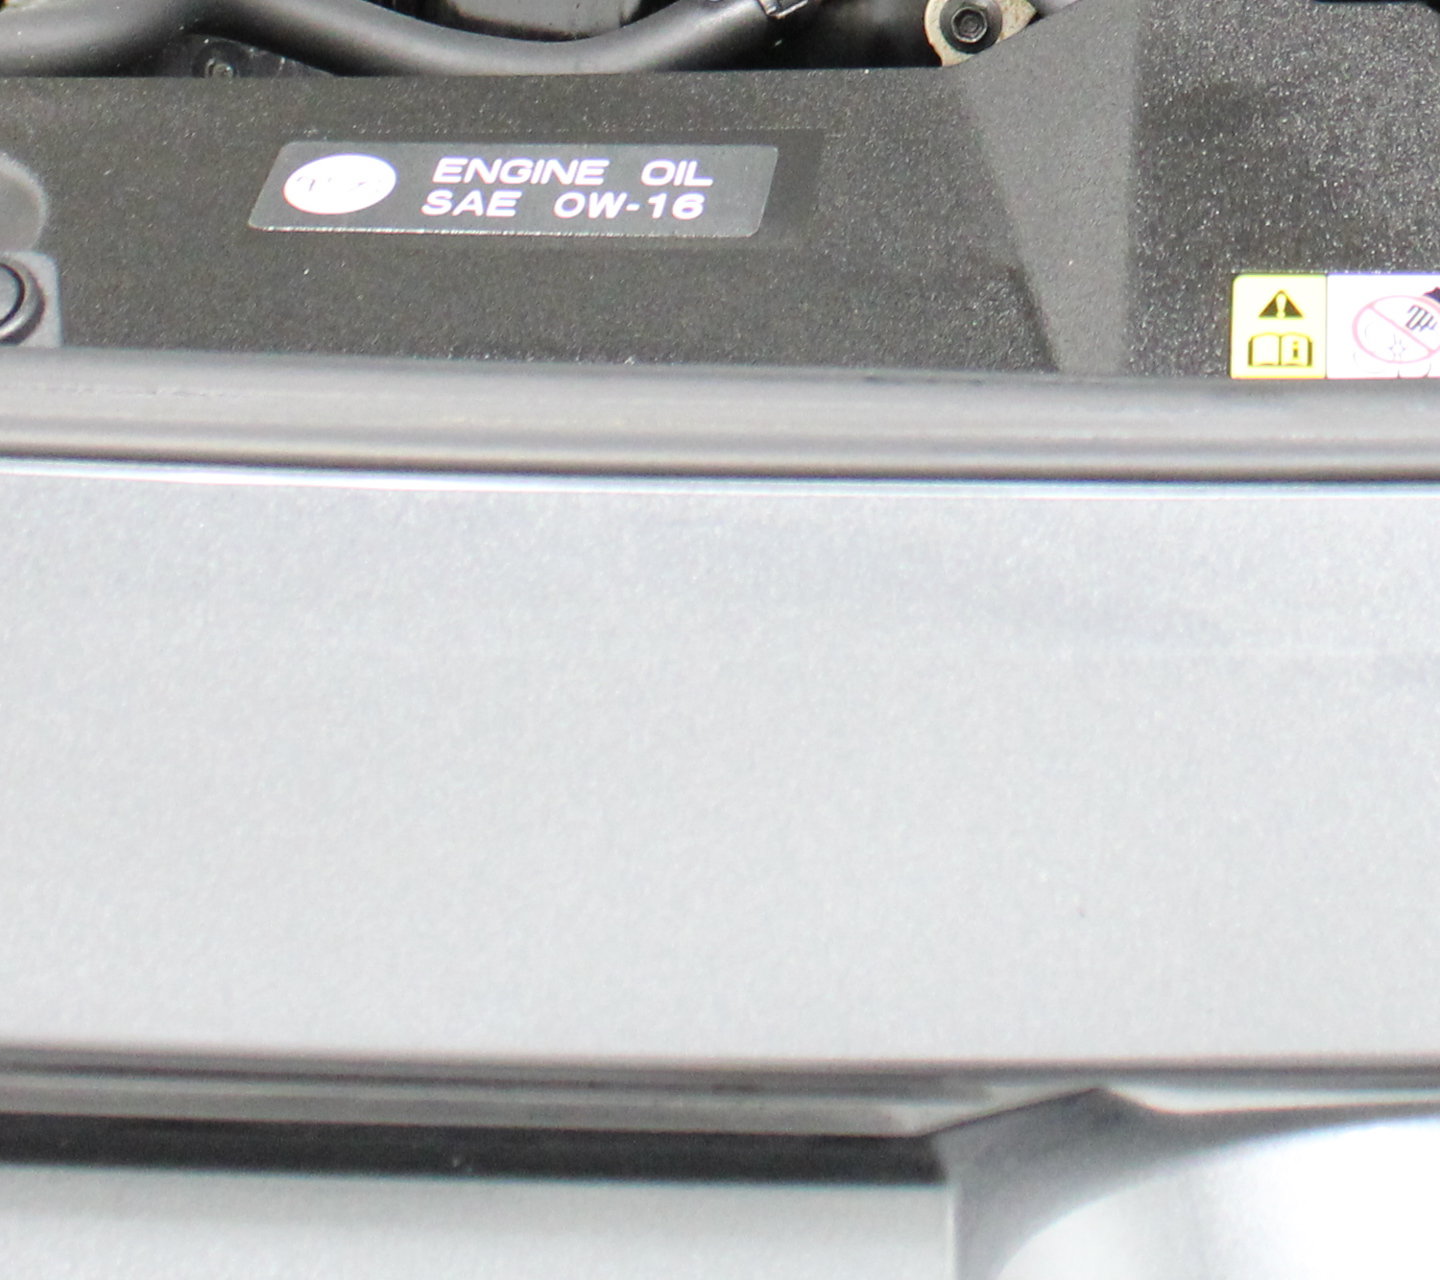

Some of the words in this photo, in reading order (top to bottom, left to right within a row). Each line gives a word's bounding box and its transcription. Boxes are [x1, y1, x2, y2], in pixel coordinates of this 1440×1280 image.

[432, 156, 610, 186] ENGINE
[641, 159, 714, 187] OIL
[420, 189, 523, 218] SAE
